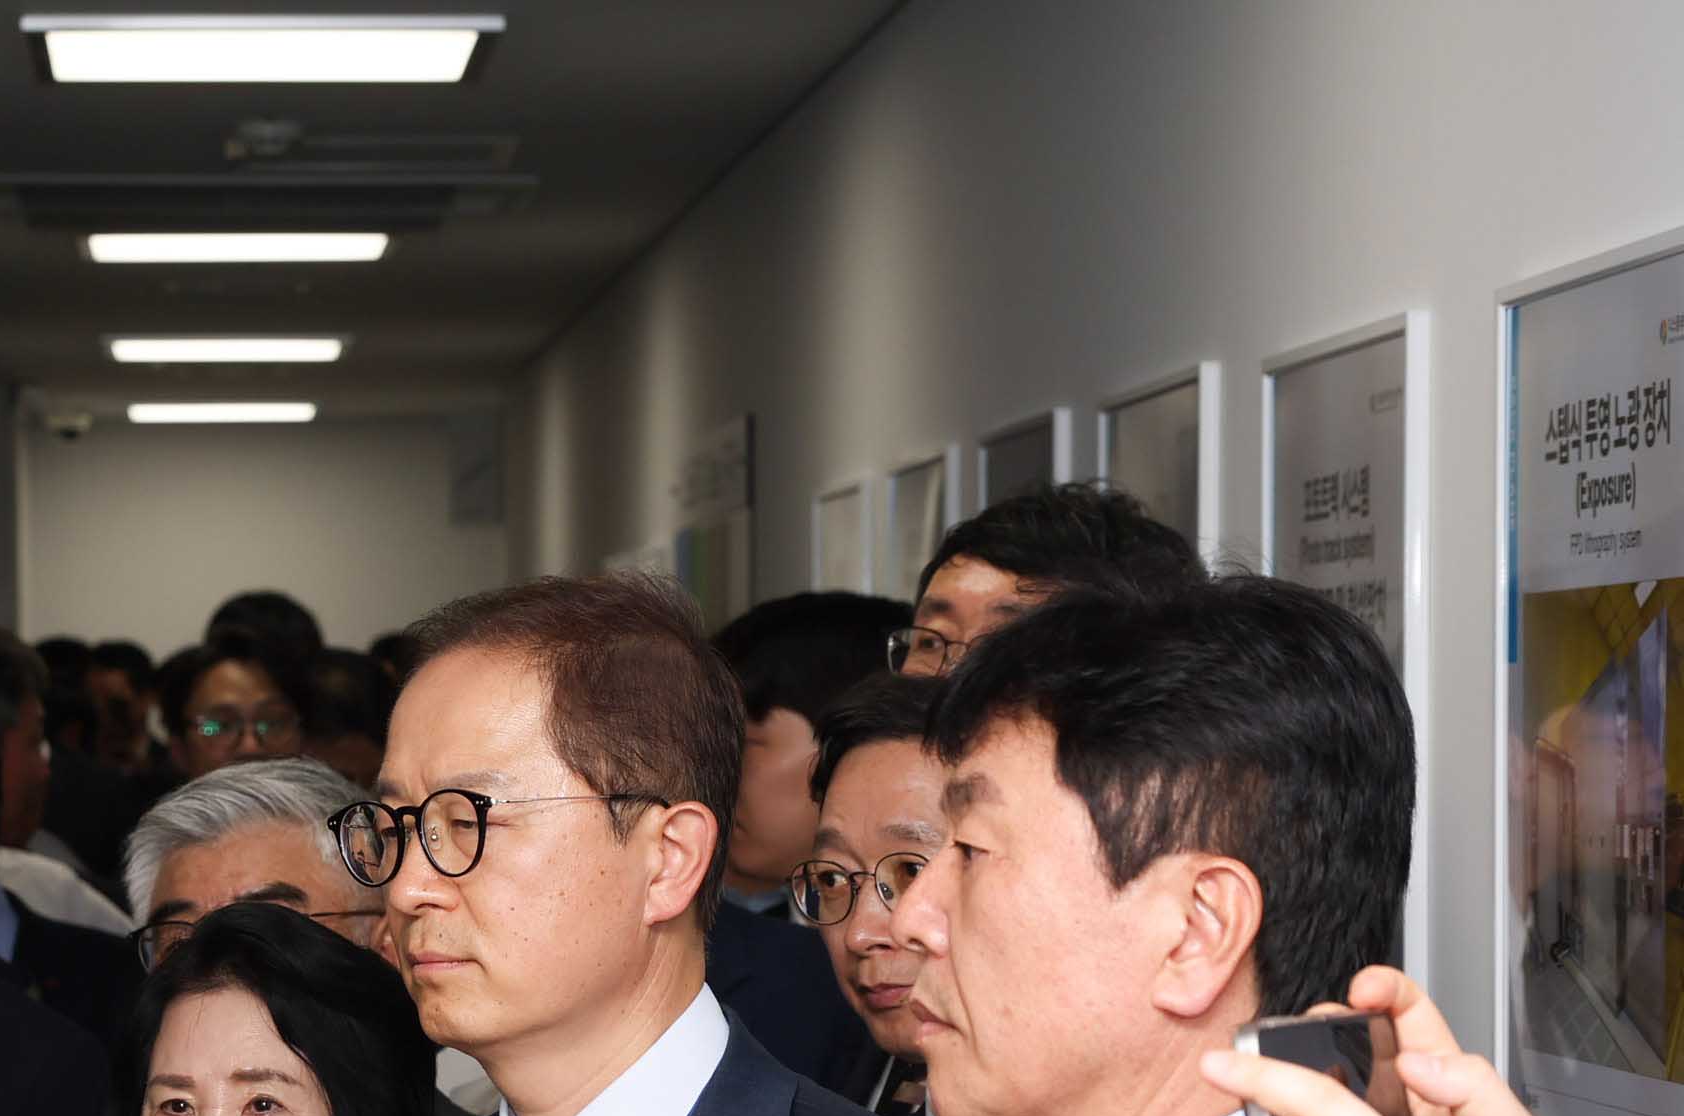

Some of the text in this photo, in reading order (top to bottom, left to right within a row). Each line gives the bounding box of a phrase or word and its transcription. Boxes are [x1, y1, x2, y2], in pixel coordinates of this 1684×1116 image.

[1545, 400, 1582, 465] 스텝식
[1585, 393, 1611, 460] 투영
[1614, 384, 1641, 451] 노광
[1643, 377, 1671, 448] 장치
[1576, 461, 1636, 519] (Exposure)
